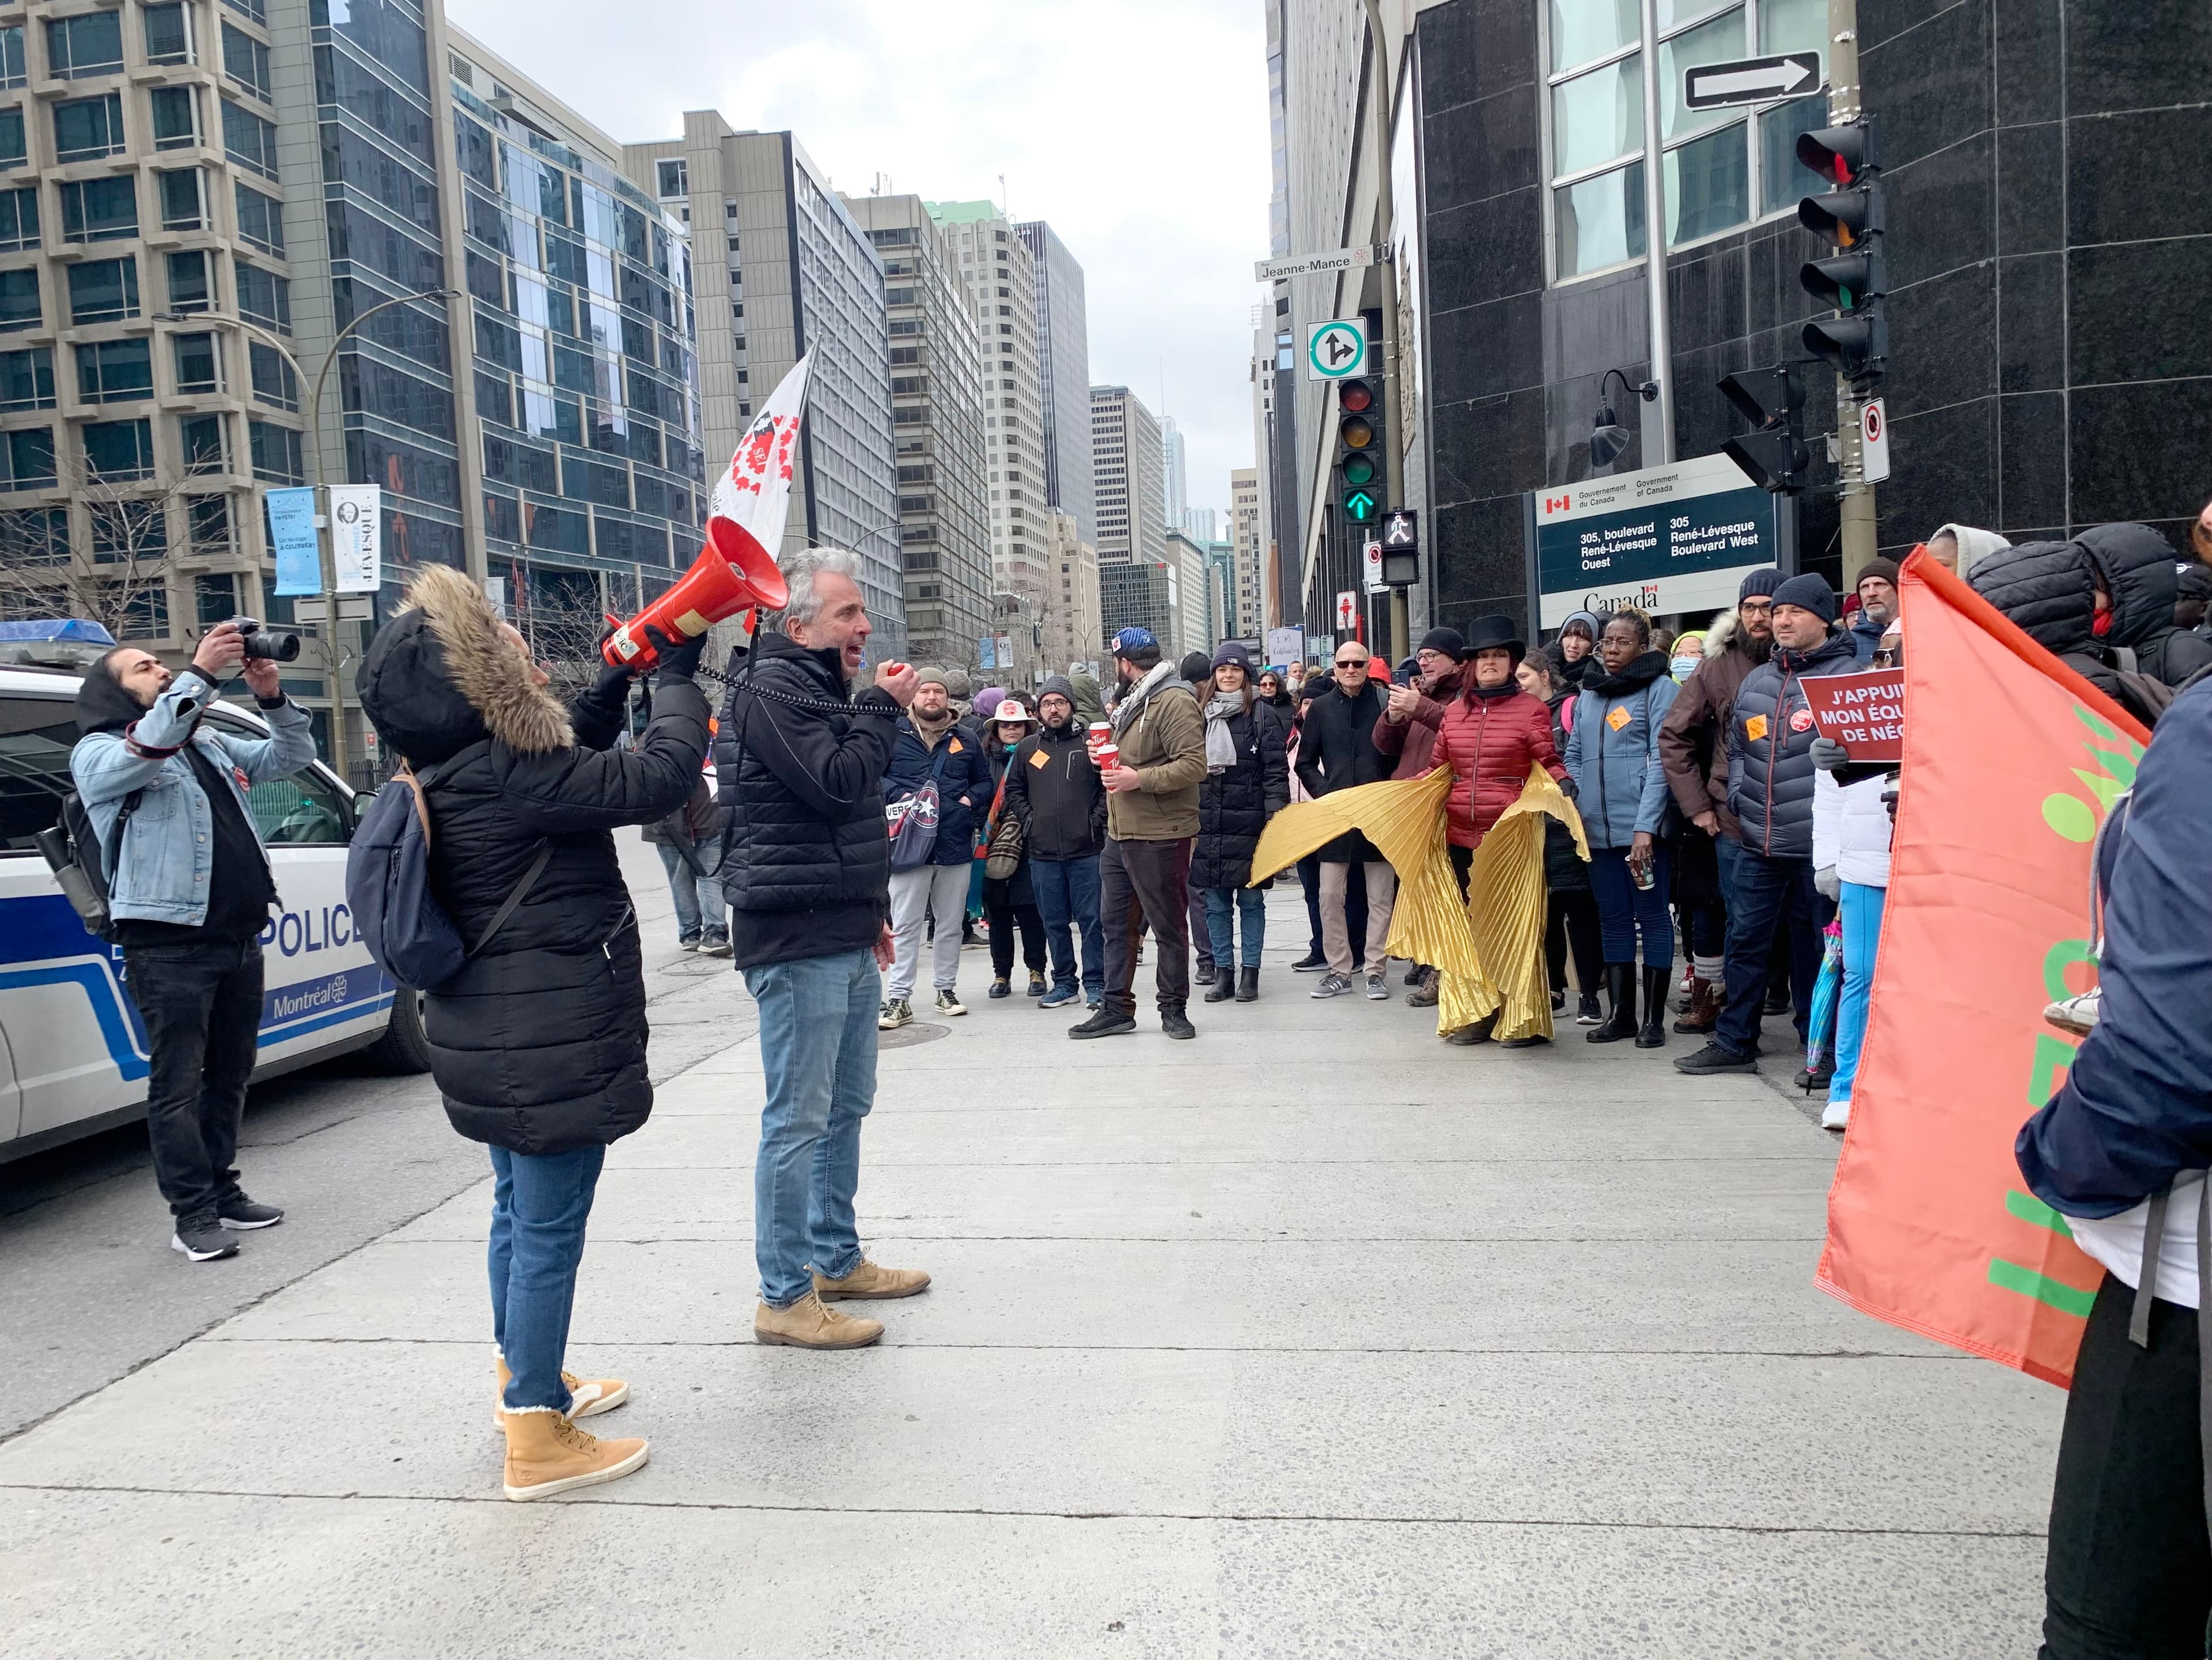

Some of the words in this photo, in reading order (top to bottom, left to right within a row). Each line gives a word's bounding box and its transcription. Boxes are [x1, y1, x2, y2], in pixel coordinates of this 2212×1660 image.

[1262, 258, 1350, 278] Jeanne-Mance
[1637, 474, 1679, 487] Government
[1579, 484, 1627, 499] Gouvernement
[1637, 489, 1643, 497] of
[1646, 485, 1673, 496] Canada
[1590, 496, 1615, 506] Canada
[1670, 516, 1690, 529] 305
[1580, 532, 1601, 544] 305,
[1604, 521, 1654, 540] boulevard
[1671, 521, 1755, 543] René-Lévesque
[361, 504, 376, 580] LÉVESQUE
[1581, 536, 1658, 558] René-Lévesque
[1671, 538, 1726, 557] Boulevard
[1730, 533, 1759, 548] West
[1582, 557, 1611, 570] Ouest
[1584, 586, 1659, 612] Canada
[1832, 683, 1904, 706] J'APPUI
[1820, 709, 1865, 725] MON
[1092, 733, 1107, 746] Tim
[1842, 728, 1869, 743] DE
[274, 982, 331, 1019] Montréal
